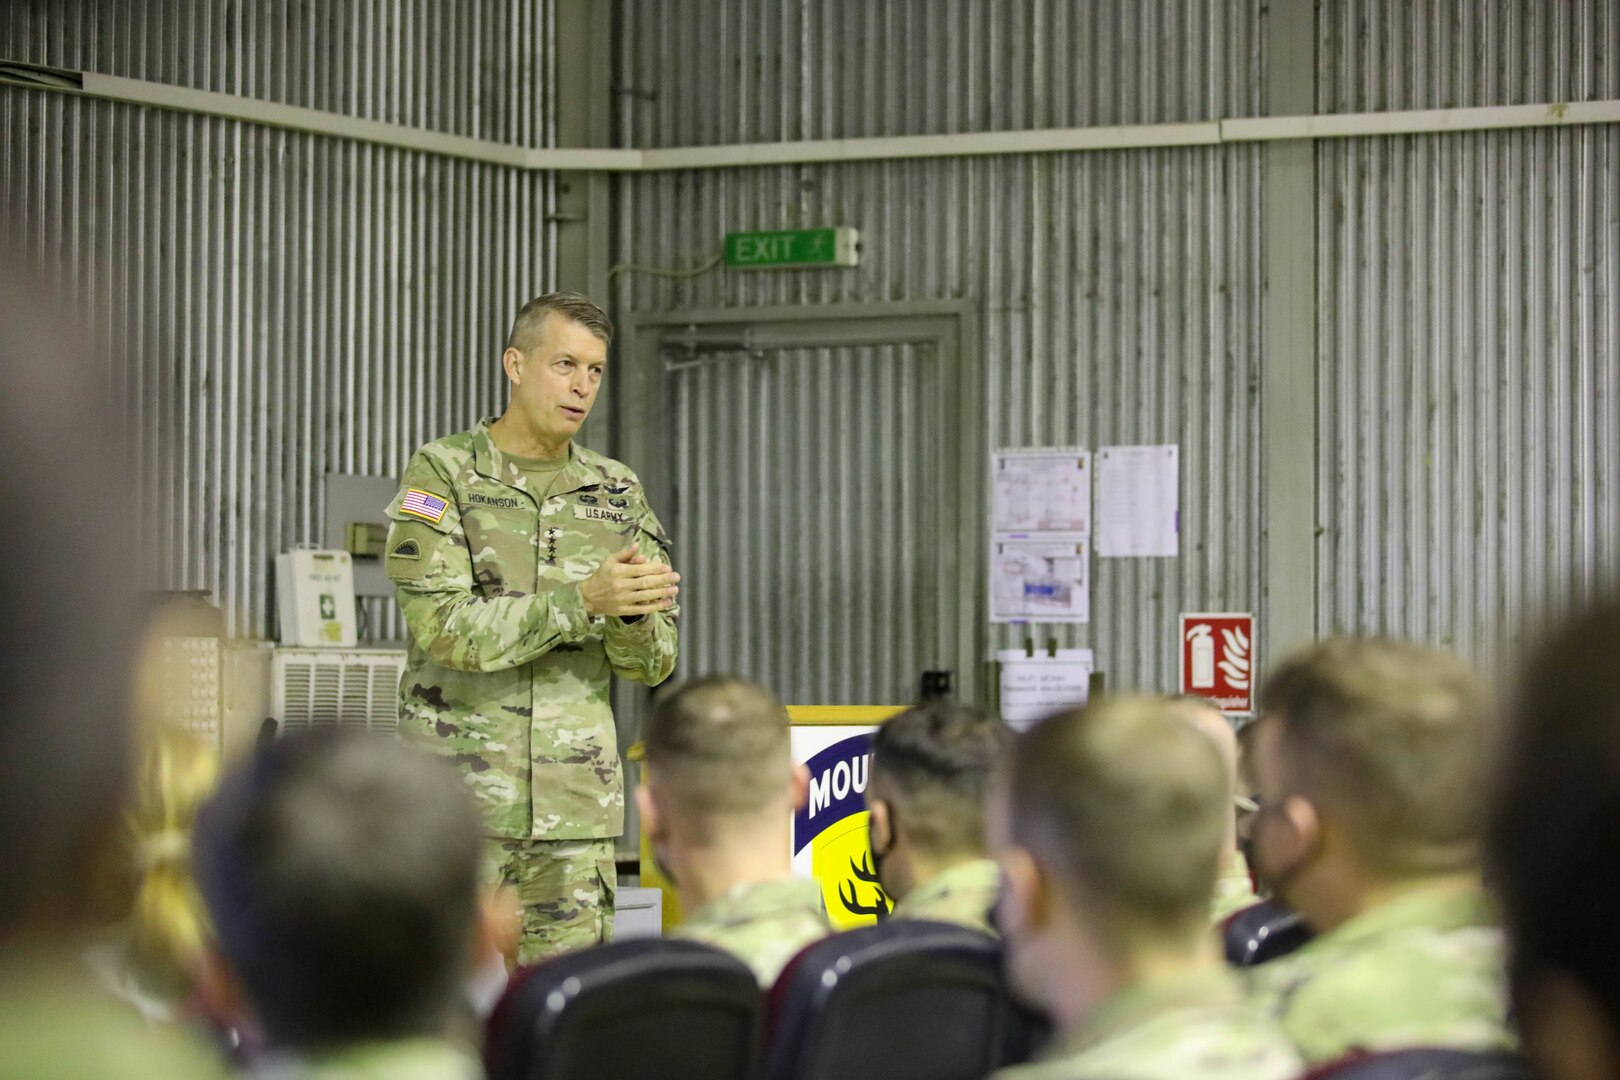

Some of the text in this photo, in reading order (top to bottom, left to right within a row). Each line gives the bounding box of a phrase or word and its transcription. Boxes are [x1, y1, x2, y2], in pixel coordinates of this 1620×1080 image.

[736, 235, 796, 261] EXIT
[468, 493, 518, 507] HOKANSON
[808, 753, 875, 819] MOU
